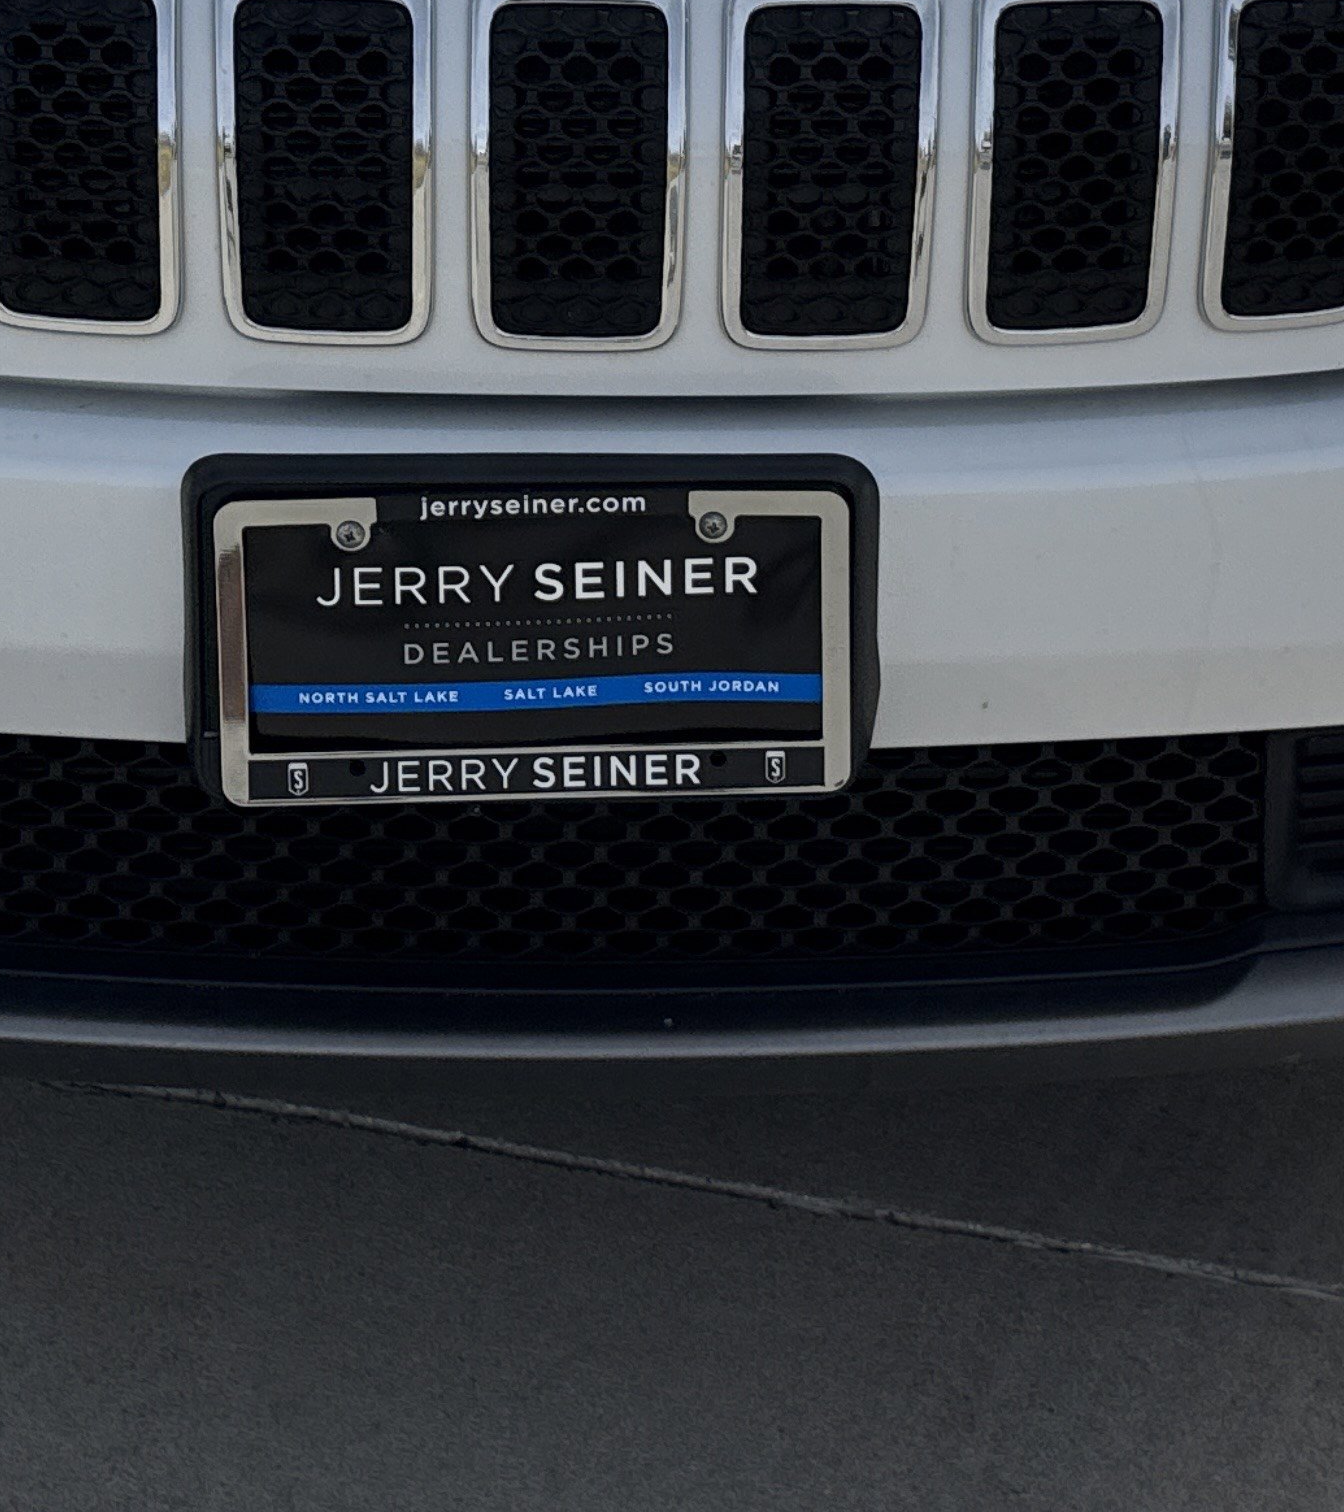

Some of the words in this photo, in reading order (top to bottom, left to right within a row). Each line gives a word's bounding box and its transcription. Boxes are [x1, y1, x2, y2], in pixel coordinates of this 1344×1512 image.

[419, 495, 647, 521] jerryseiner.com
[316, 564, 515, 607] JERRY
[534, 556, 758, 602] SEINER
[403, 633, 674, 665] DEALERSHIPS
[299, 692, 359, 705] NORTH
[365, 692, 407, 704] SALT
[414, 690, 459, 703] LAKE
[504, 687, 546, 701] SALT
[553, 685, 598, 699] LAKE
[644, 680, 702, 694] SOUTH
[708, 680, 780, 693] JORDAN
[370, 758, 518, 793] JERRY
[533, 753, 701, 788] SEINER
